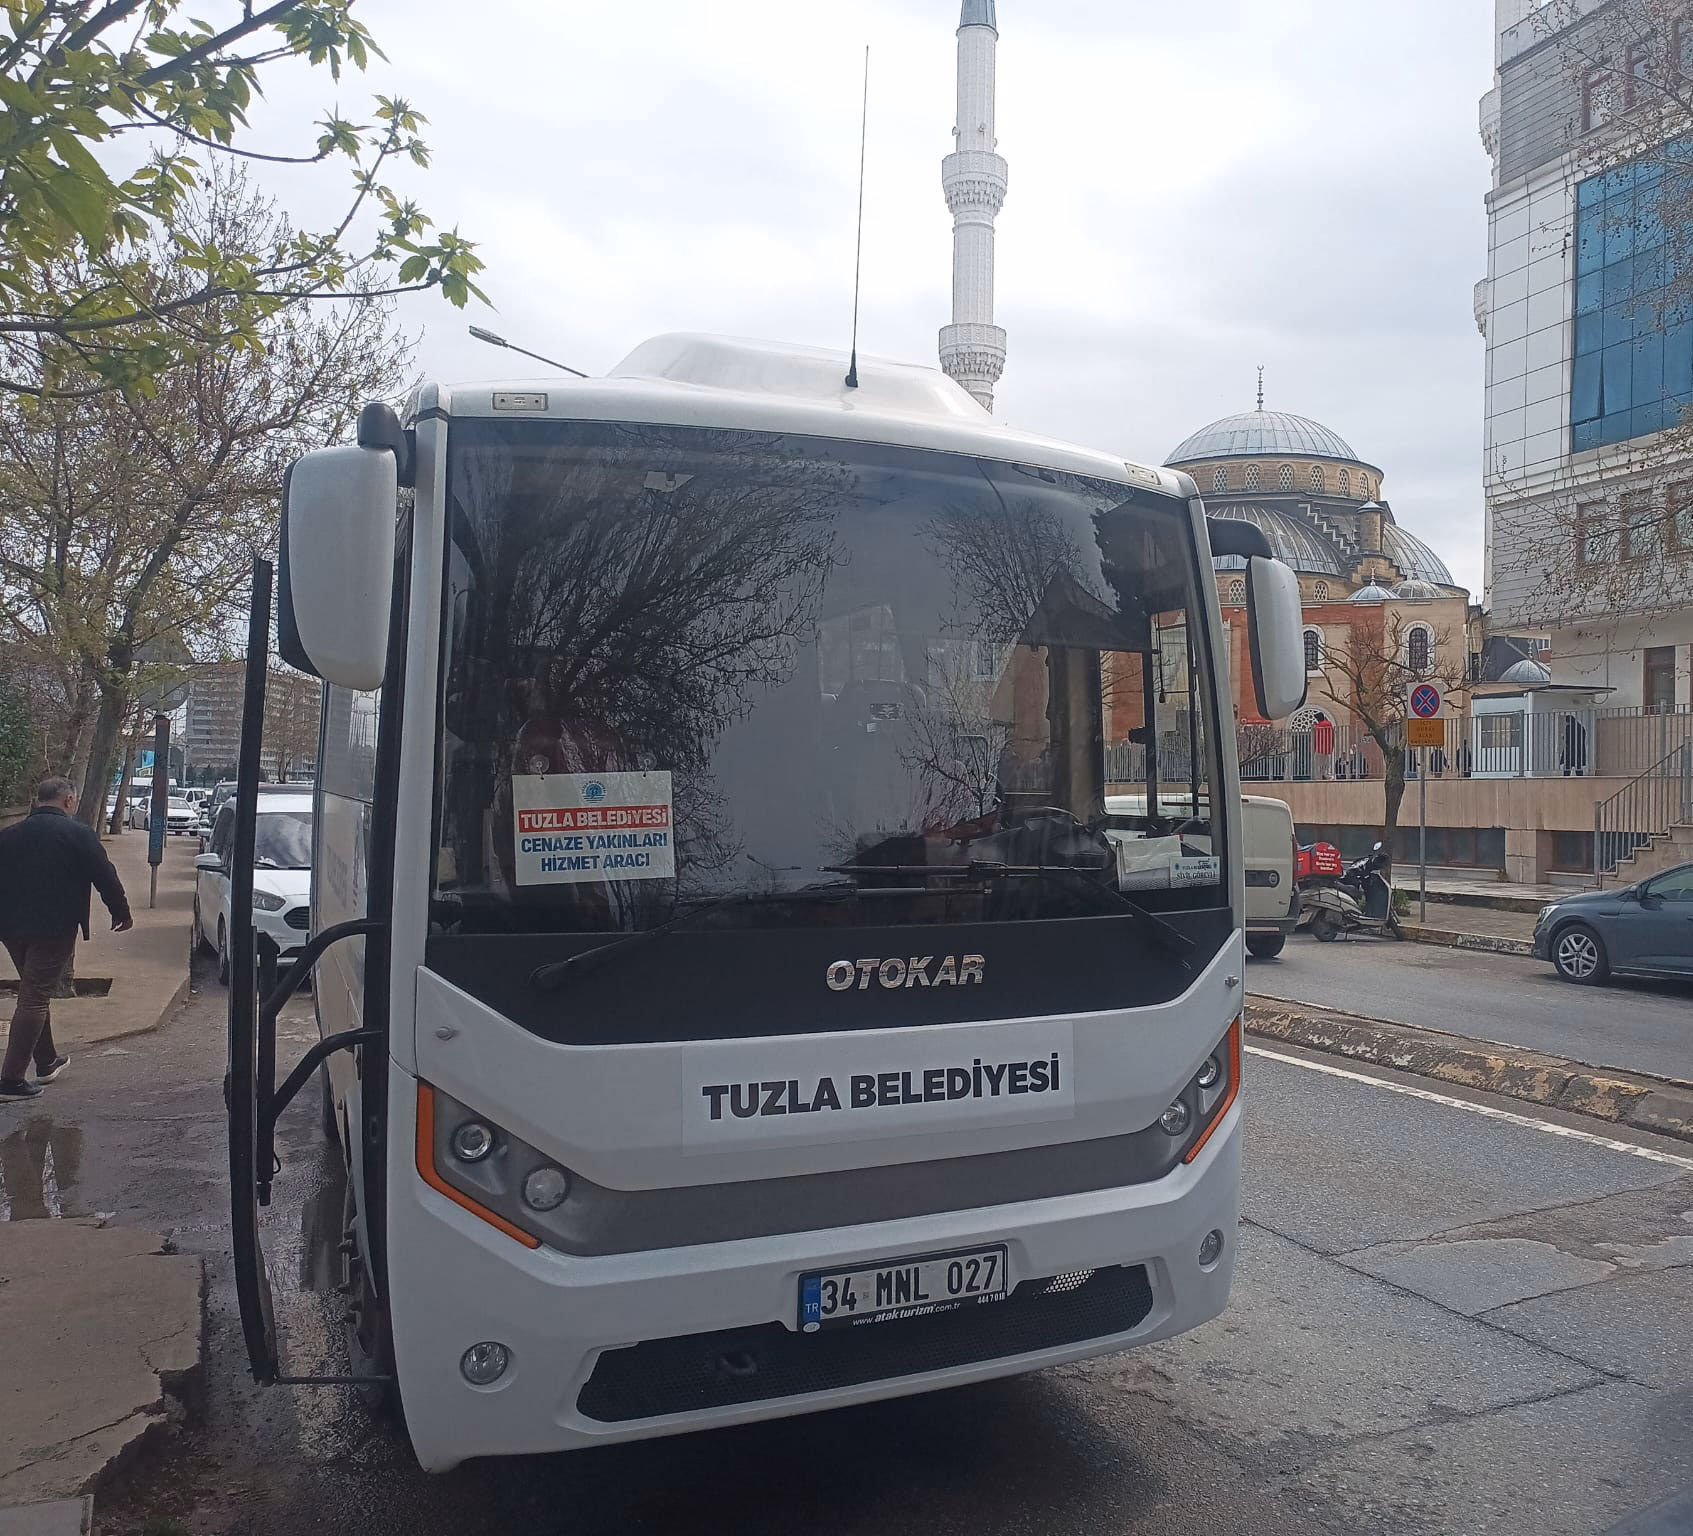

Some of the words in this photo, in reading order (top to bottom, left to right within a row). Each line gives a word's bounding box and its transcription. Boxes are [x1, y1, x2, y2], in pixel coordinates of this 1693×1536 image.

[521, 812, 574, 829] TUZLA
[521, 837, 583, 852] CENAZE
[586, 833, 668, 850] YAKINLARI
[541, 854, 600, 871] HİZMET
[603, 853, 650, 869] ARACI
[826, 954, 985, 991] OTOKAR
[702, 1077, 842, 1120] TUZLA
[850, 1052, 1060, 1108] BELEDİYESİ
[821, 1278, 857, 1315] 34
[876, 1266, 930, 1307] MNL
[948, 1255, 998, 1295] 027
[805, 1302, 818, 1314] TR
